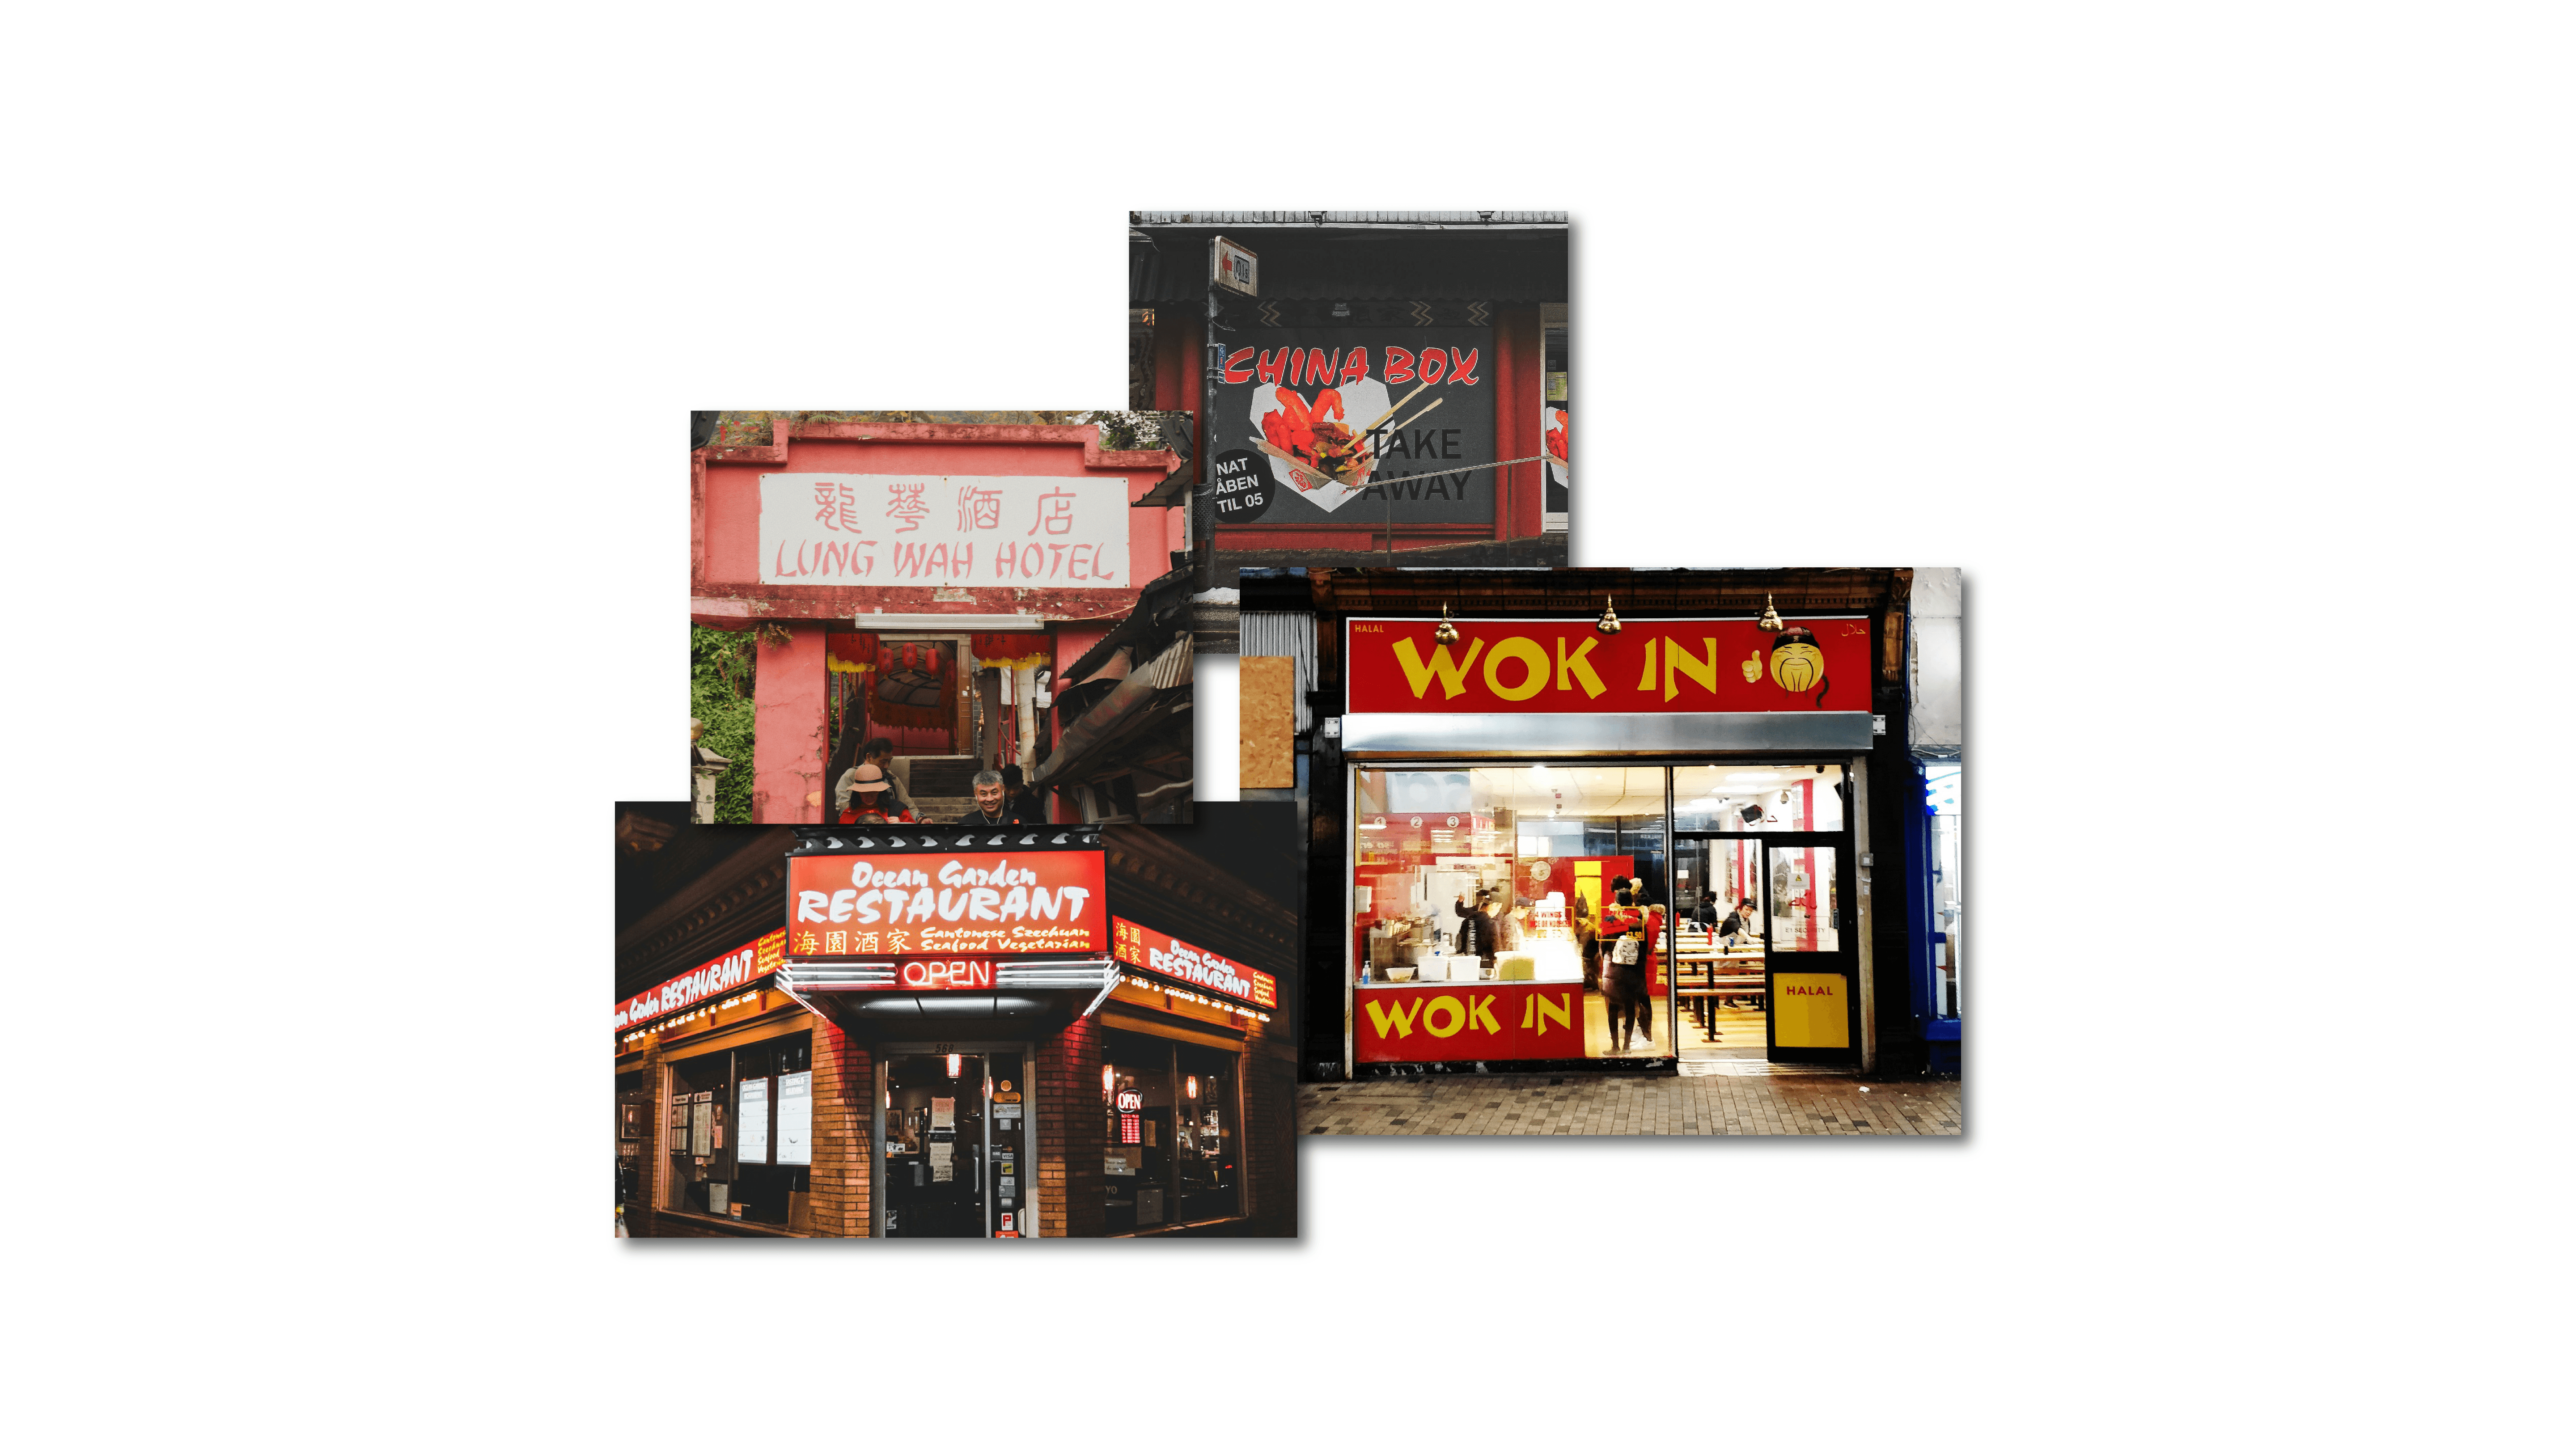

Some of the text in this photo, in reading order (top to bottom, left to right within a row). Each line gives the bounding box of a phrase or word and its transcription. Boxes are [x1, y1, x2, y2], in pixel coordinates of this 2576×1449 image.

[1224, 346, 1479, 386] CHINA BOX
[1366, 429, 1462, 459] TAKE
[1216, 457, 1247, 475] NAT
[1216, 474, 1258, 495] ÅBEN
[1362, 470, 1471, 501] AWAY
[1217, 493, 1263, 512] TIL 05
[775, 540, 1114, 581] LUNG WAH HOTEL
[1355, 625, 1384, 633] HALAL
[1842, 624, 1865, 636] حلال
[1392, 636, 1716, 703] WOK IN
[852, 860, 1036, 887] Ocean Garden
[797, 886, 1090, 924] RESTAURANT
[794, 929, 912, 955] 海園酒家
[920, 925, 1090, 938] Cantonese Szechuan
[1116, 923, 1140, 946] 海園
[920, 938, 1090, 951] Seafood Vegetarian
[1115, 942, 1141, 964] 酒家
[1171, 939, 1235, 976] Ocean Garden
[904, 961, 990, 985] OPEN
[1149, 948, 1250, 998] RESTAURANT
[629, 992, 659, 1022] Garden
[661, 950, 753, 1012] RESTAURANT
[1787, 986, 1833, 995] HALAL
[1366, 993, 1570, 1039] WOK IN
[935, 1043, 954, 1052] 568
[1118, 1093, 1140, 1109] OPEN
